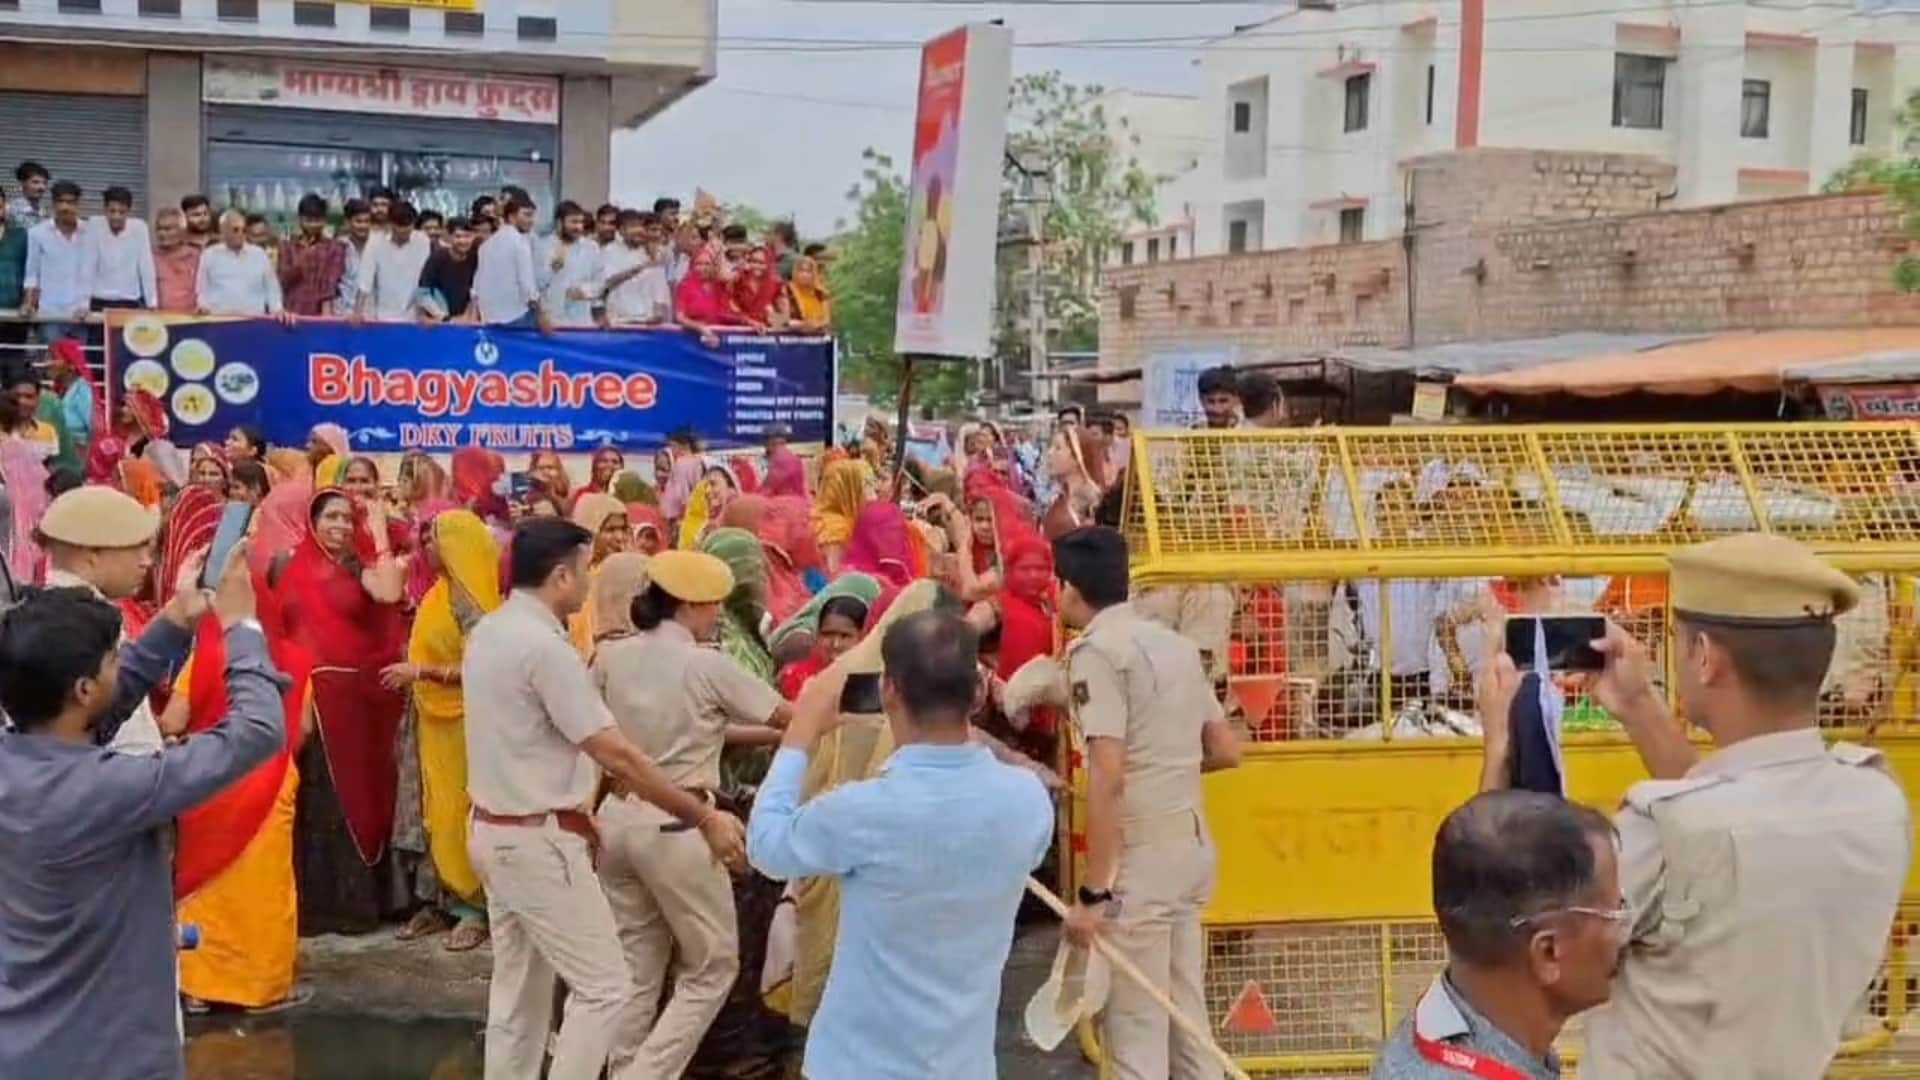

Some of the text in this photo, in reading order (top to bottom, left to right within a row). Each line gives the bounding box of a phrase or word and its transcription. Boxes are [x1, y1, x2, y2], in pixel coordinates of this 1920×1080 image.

[284, 67, 401, 104] भाग्यश्री
[309, 353, 657, 416] Bhagyashree
[469, 422, 575, 449] FRUITS
